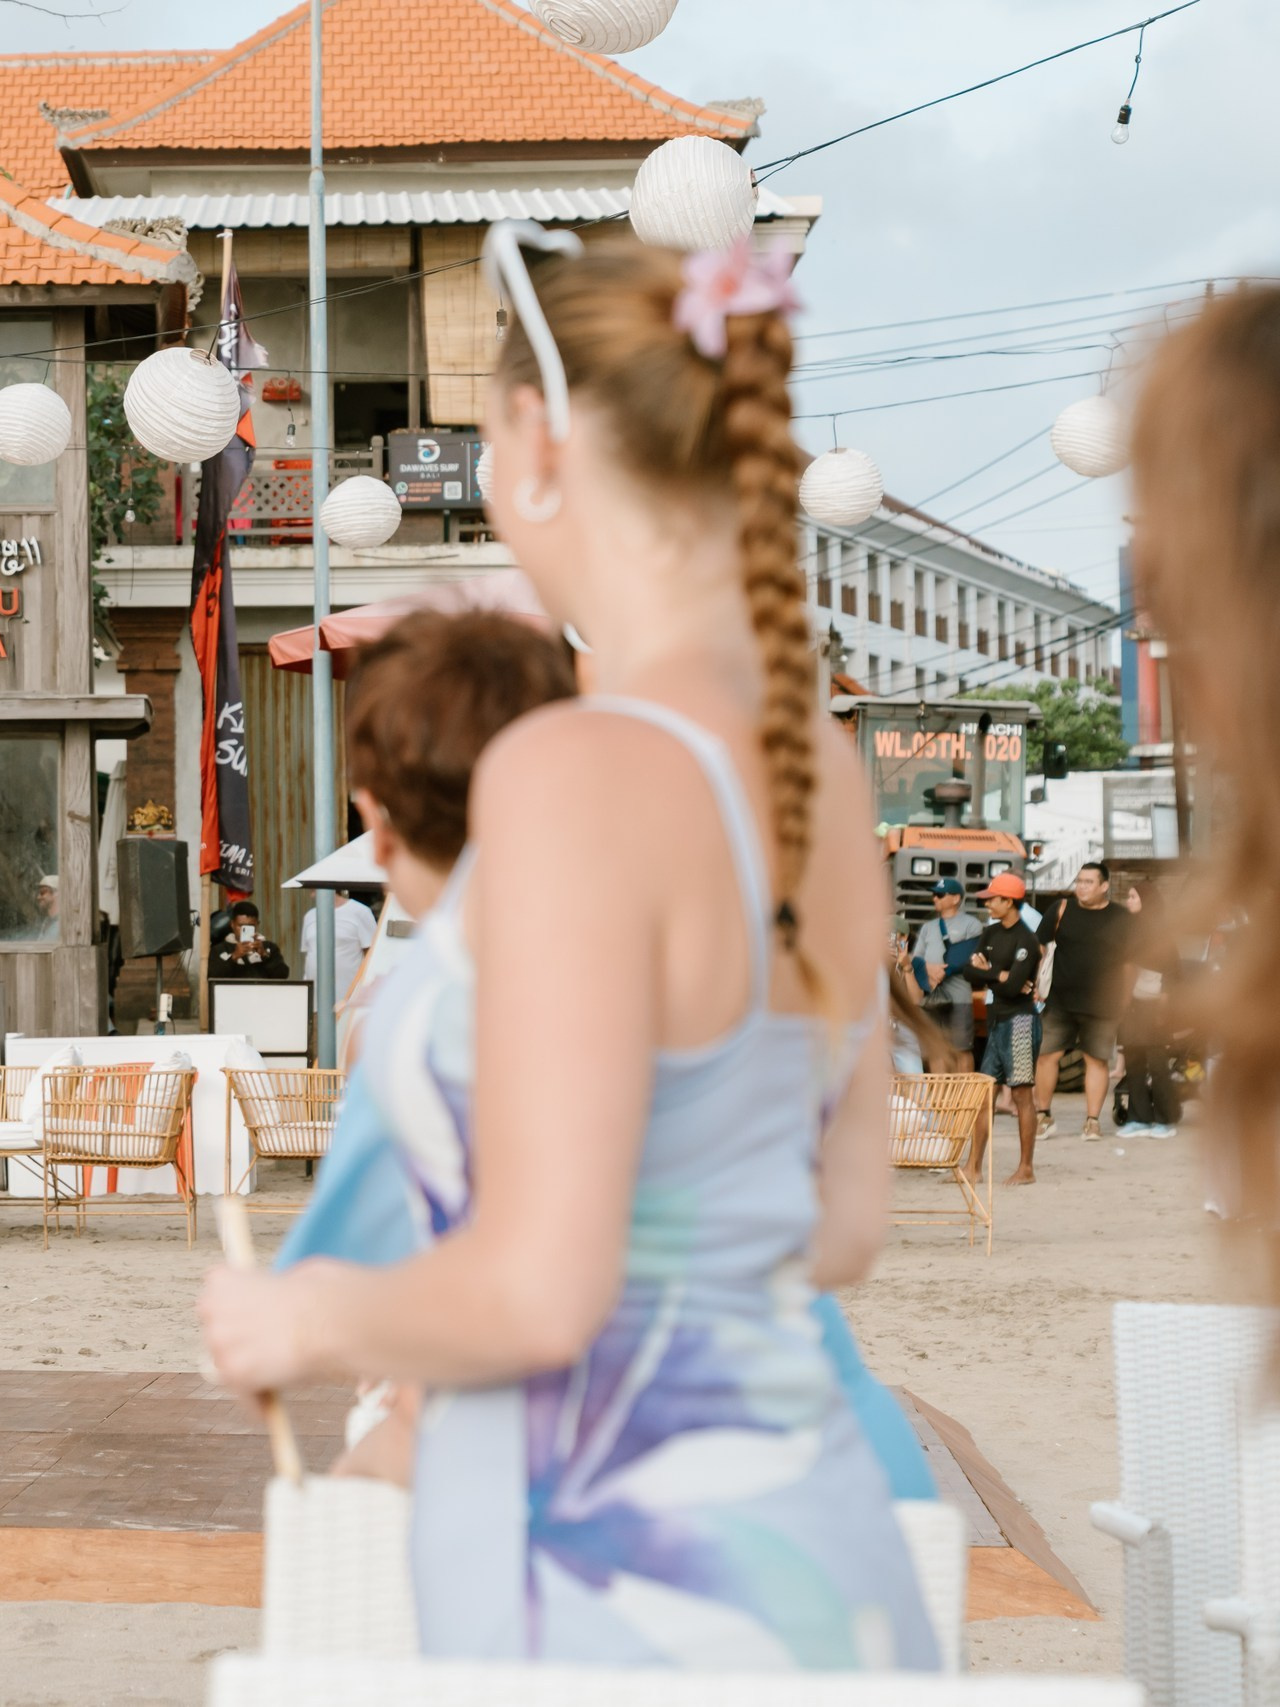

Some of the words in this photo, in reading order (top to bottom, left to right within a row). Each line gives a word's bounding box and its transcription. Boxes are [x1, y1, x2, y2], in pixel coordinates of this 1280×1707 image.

[400, 463, 439, 473] DAWAVES
[440, 463, 459, 472] SURF
[960, 723, 1022, 736] HIACHI
[874, 730, 1022, 762] WL.05TH.020
[219, 842, 247, 864] IMA
